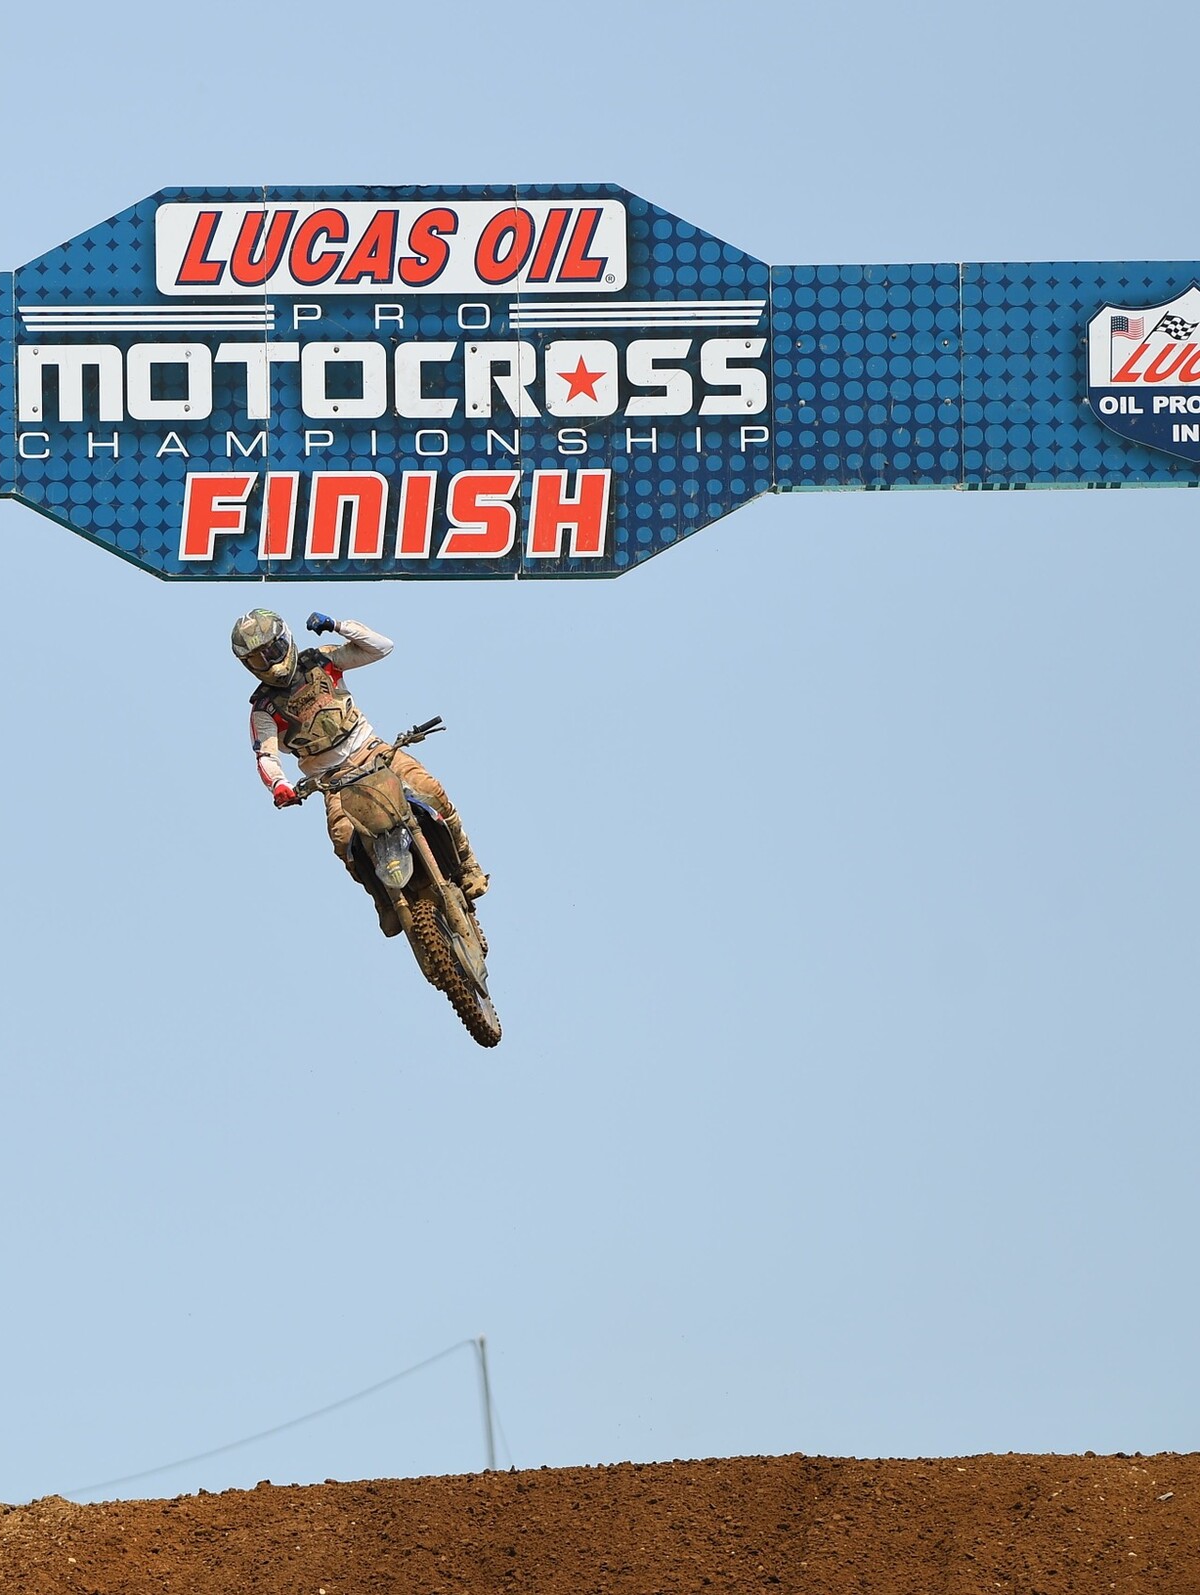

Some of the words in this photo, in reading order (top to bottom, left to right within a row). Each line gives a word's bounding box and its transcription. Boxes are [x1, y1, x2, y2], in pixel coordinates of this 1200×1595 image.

[175, 208, 458, 287] LUCAS
[474, 206, 607, 286] OIL
[293, 303, 491, 330] PRO
[17, 338, 767, 422] MOTOCROSS
[1099, 396, 1144, 415] OIL
[18, 426, 770, 459] CHAMPIONSHIP
[178, 468, 612, 561] FINISH
